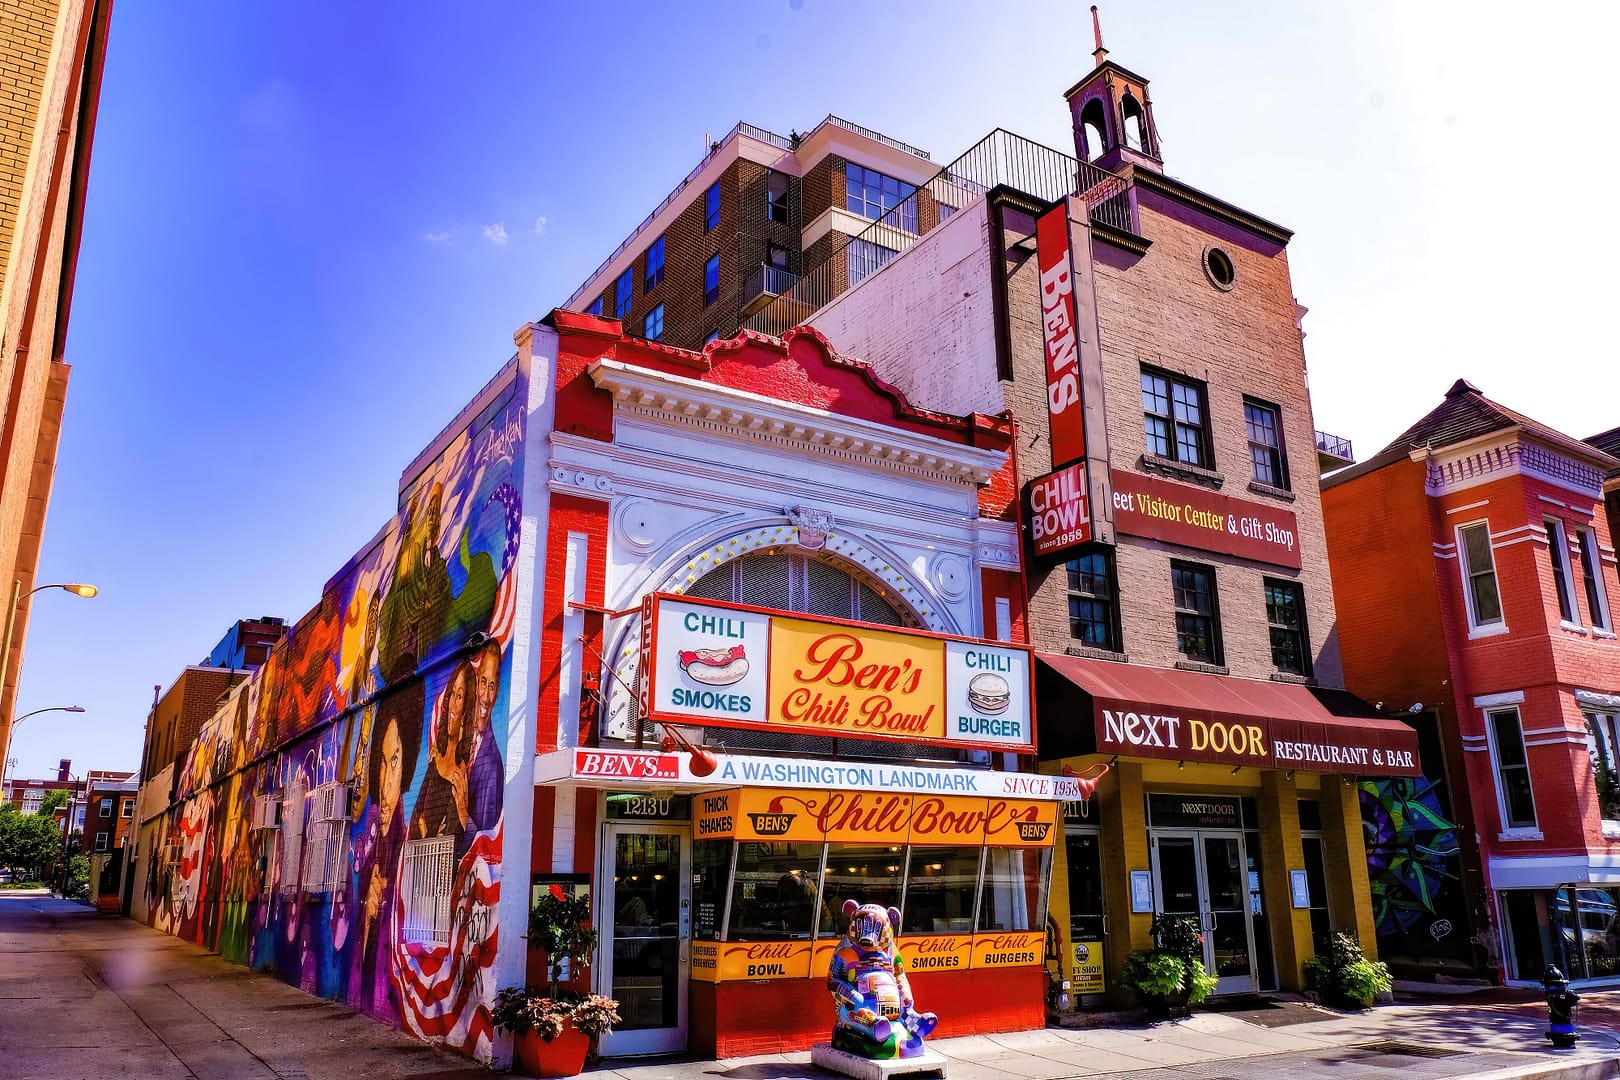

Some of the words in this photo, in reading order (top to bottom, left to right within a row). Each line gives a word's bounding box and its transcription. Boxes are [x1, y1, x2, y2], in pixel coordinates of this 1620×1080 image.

[1040, 249, 1078, 415] BEN'S
[1031, 468, 1086, 513] CHILI
[1032, 499, 1089, 540] BOWL
[1113, 491, 1134, 512] eet
[1136, 493, 1181, 523] Visitor
[1184, 504, 1224, 532] Center
[1227, 514, 1238, 535] &
[1241, 517, 1263, 540] Gift
[1265, 522, 1294, 552] Shop
[1055, 529, 1083, 547] 1958
[684, 612, 745, 639] CHILI
[640, 596, 653, 717] BEN'S
[794, 633, 923, 695] Ben's
[965, 650, 1011, 673] CHILI
[671, 688, 752, 713] SMOKES
[781, 687, 849, 725] Chili
[854, 695, 936, 734] Bowl
[958, 716, 1021, 738] BURGER
[1188, 719, 1267, 757] DOOR
[1273, 740, 1368, 766] RESTAURANT
[1372, 752, 1384, 767] &
[1385, 749, 1415, 768] BAR
[721, 760, 737, 779] A
[742, 762, 873, 786] WASHINGTON
[878, 769, 978, 792] LANDMARK
[1003, 777, 1049, 795] SINCE
[1053, 780, 1078, 797] 1958
[624, 797, 657, 815] 1213
[703, 795, 728, 814] THICK
[815, 794, 913, 834] Chili
[913, 797, 1009, 835] Bowl
[699, 816, 733, 834] SHAKES
[755, 815, 790, 832] BEN'S
[1021, 824, 1046, 838] BEN'S
[746, 944, 793, 960] Chili
[916, 938, 955, 953] Chili
[993, 935, 1029, 950] Chili
[911, 955, 960, 969] SMOKES
[984, 952, 1035, 964] BURGERS
[747, 963, 786, 977] BOWL
[1081, 965, 1101, 974] SHOP
